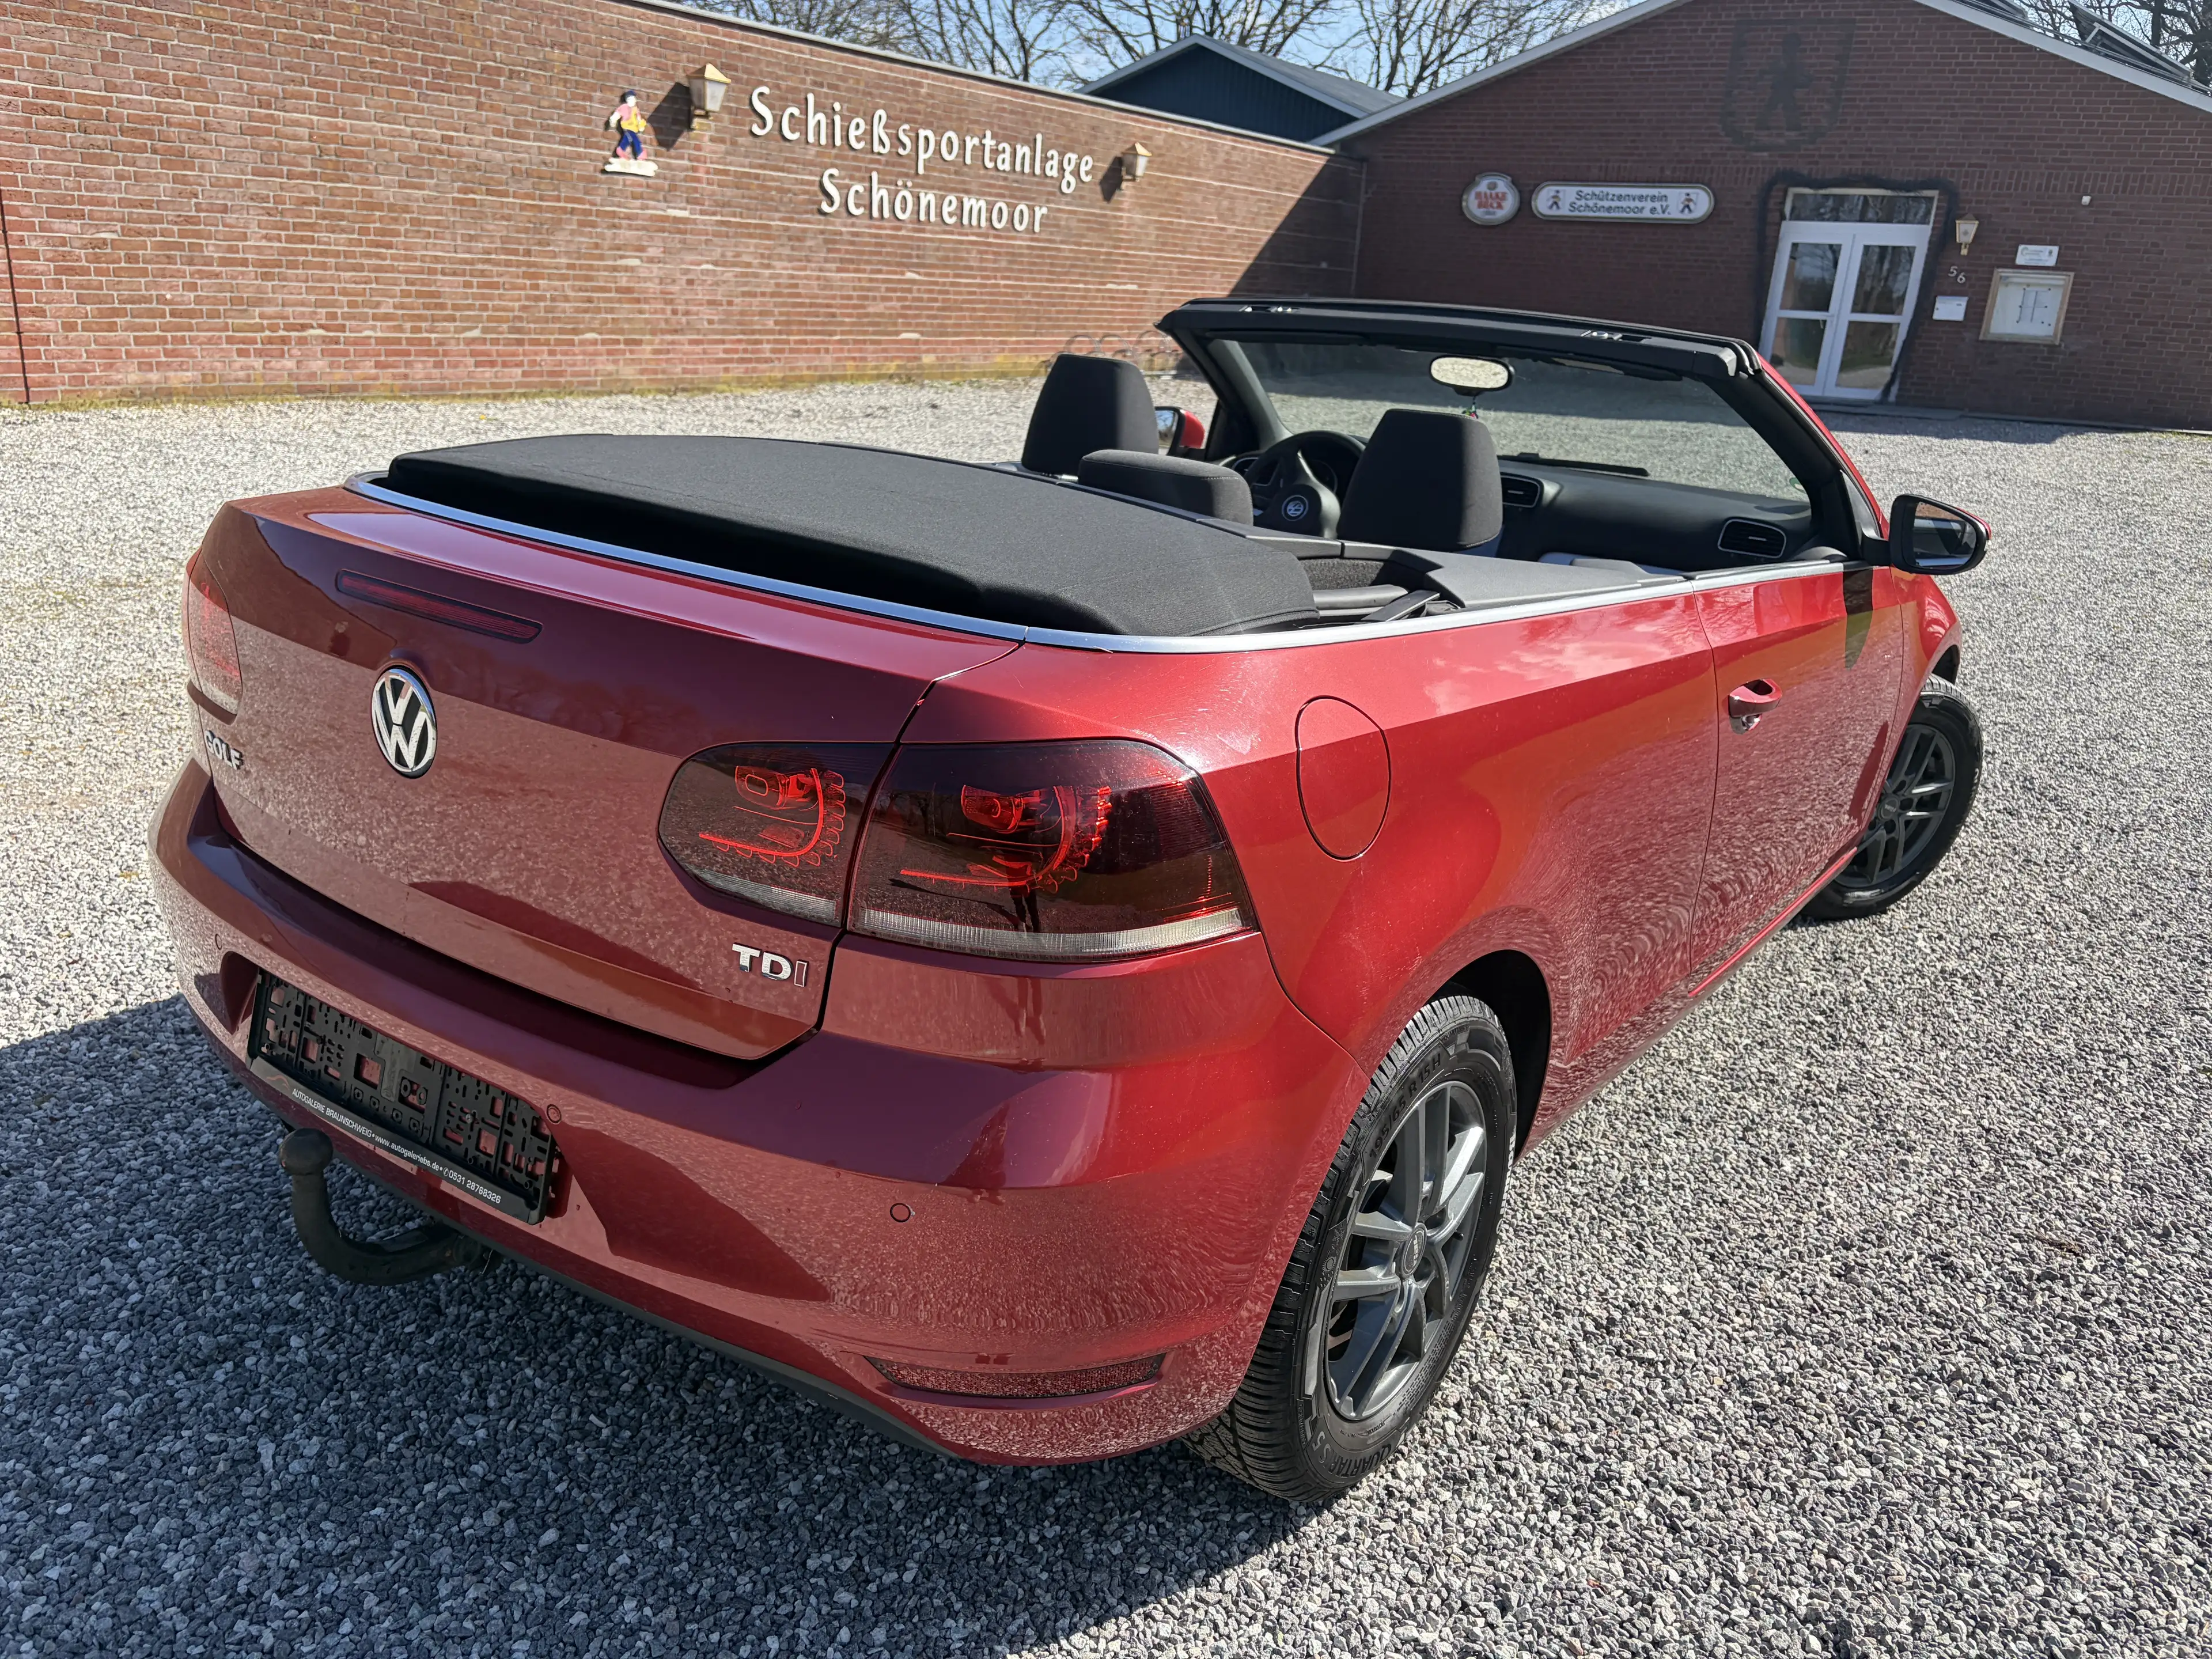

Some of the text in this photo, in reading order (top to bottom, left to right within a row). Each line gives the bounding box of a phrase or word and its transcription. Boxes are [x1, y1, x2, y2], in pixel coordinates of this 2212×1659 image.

[751, 85, 1093, 194] Schießsportanlage
[820, 168, 1048, 232] Schönemoor
[1568, 201, 1672, 215] Schönemoor e.V.
[1575, 189, 1668, 203] Schützenverein
[204, 730, 244, 771] GOLF
[732, 943, 809, 987] TDI
[292, 1088, 502, 1204] AUTOGALERIE BRAUNSCHWEIG www.autogaleriebs.de 0531 28768326
[1369, 1094, 1406, 1158] 195/65
[1312, 1431, 1325, 1452] 5
